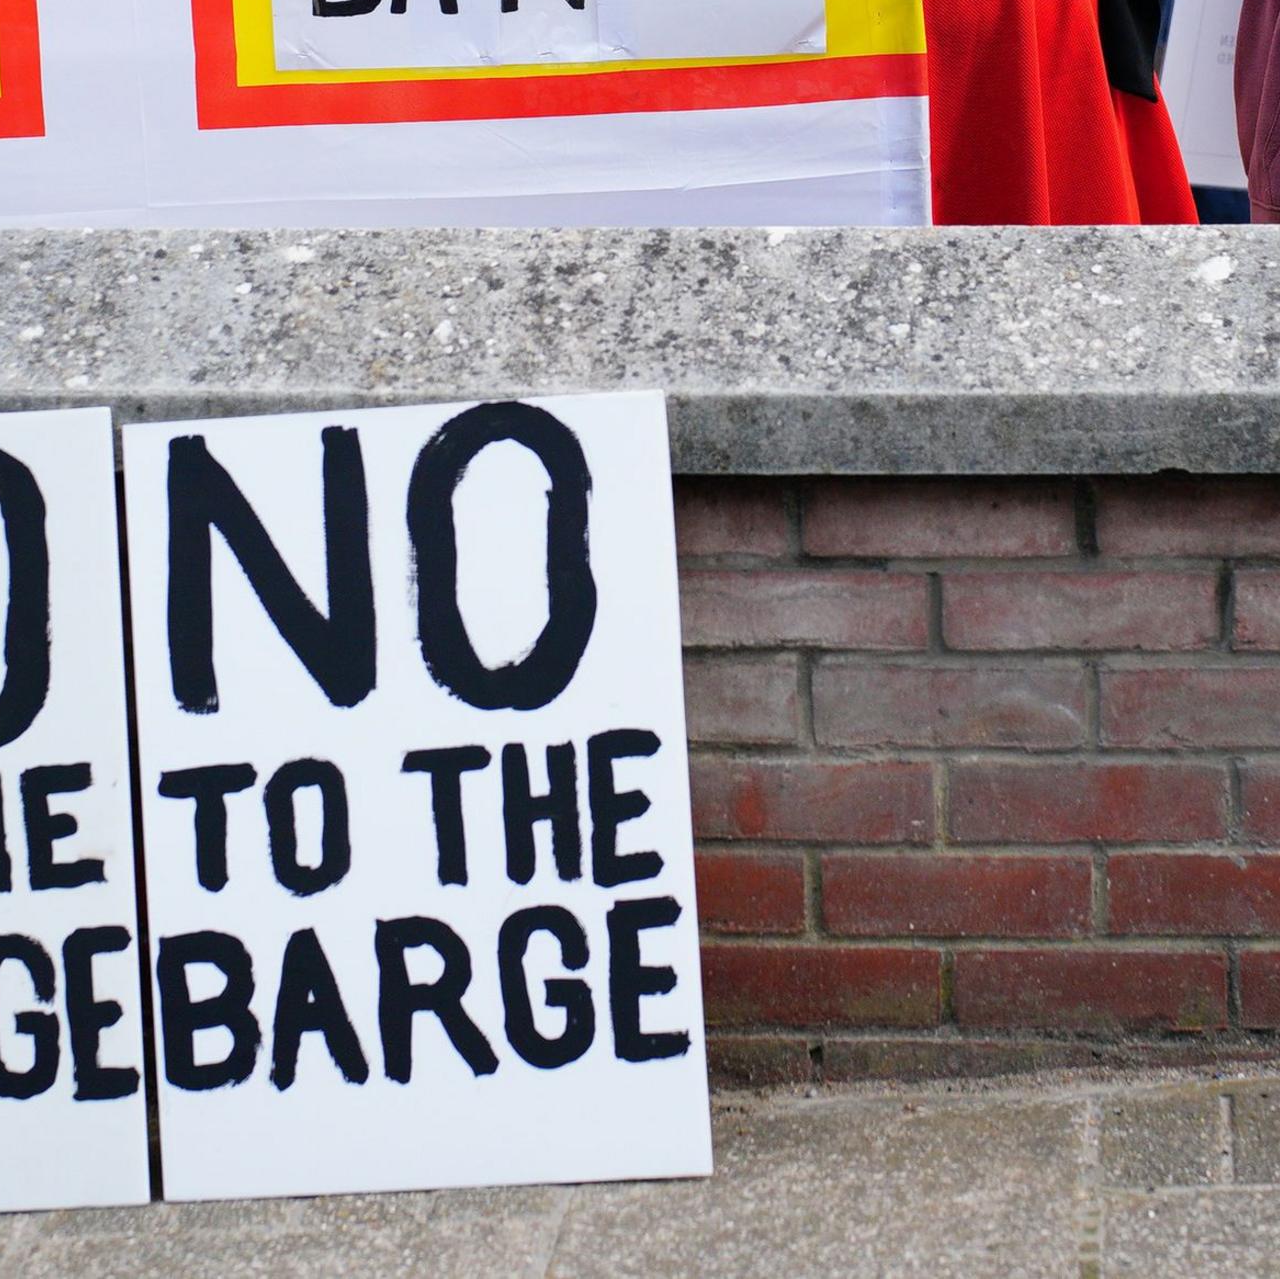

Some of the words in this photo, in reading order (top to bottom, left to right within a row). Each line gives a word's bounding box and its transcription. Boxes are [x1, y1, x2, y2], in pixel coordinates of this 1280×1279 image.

[166, 401, 599, 713] NO
[157, 757, 352, 897] TO
[401, 728, 666, 890] THE
[157, 895, 692, 1092] BARGE
